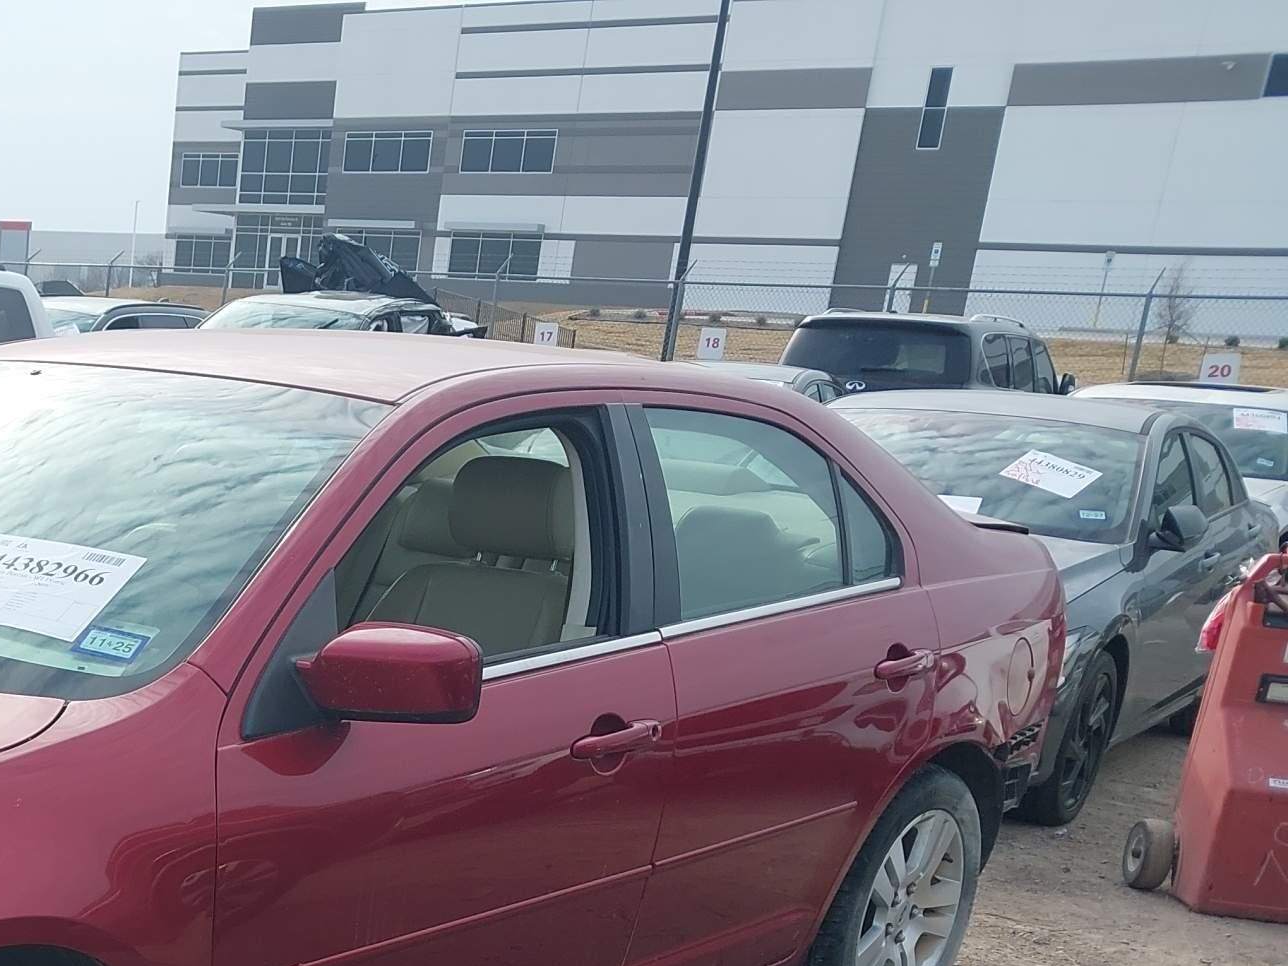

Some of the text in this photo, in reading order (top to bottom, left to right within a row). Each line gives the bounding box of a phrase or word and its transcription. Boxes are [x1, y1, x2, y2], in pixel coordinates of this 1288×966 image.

[539, 331, 554, 342] 17
[704, 337, 720, 349] 18
[1207, 364, 1232, 378] 20
